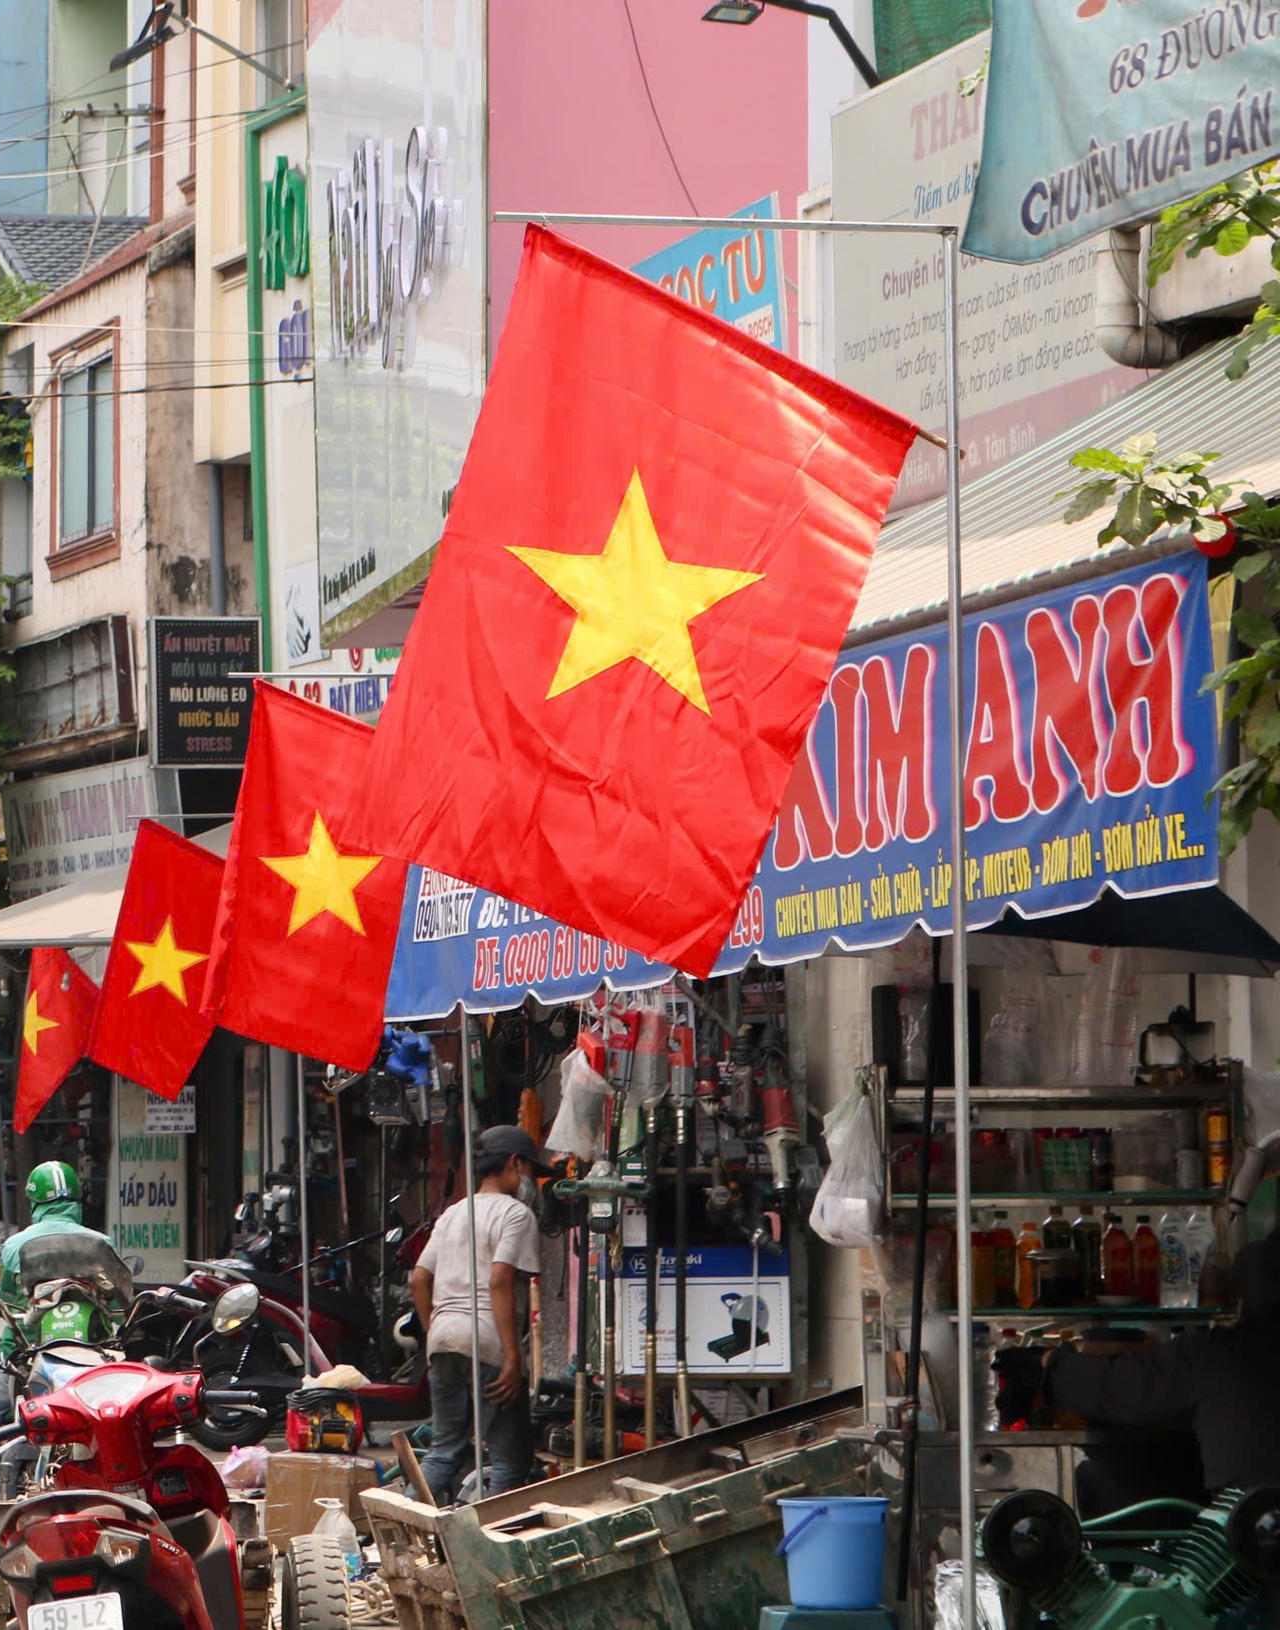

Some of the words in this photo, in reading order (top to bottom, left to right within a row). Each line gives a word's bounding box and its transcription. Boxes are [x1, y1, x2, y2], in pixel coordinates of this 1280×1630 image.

[1108, 41, 1149, 94] 68
[1021, 138, 1120, 236] CHUYÊN
[1126, 119, 1192, 195] MUA
[1203, 83, 1273, 167] BÁN
[914, 180, 943, 220] Tiệm
[882, 264, 929, 300] Chuyên
[1063, 292, 1094, 322] khoan
[198, 661, 217, 678] VAI
[169, 683, 195, 702] MỎI
[231, 686, 248, 702] EO
[773, 642, 940, 874] KIM
[961, 572, 1196, 834] ANH
[186, 736, 233, 752] STRESS
[60, 782, 112, 843] THANH
[775, 884, 816, 939] CHUYÊN
[815, 886, 840, 931] MUA
[839, 874, 863, 926] BÁN
[871, 862, 893, 920] SỬA
[893, 862, 924, 916] CHỮA
[931, 847, 954, 909] LẮP
[983, 846, 1033, 898] MOTEUR
[1041, 834, 1069, 887] BƠM
[1071, 828, 1093, 881] HƠI
[1102, 821, 1134, 874] BƠM
[1135, 803, 1163, 867] RỬA
[472, 936, 501, 992] ĐT:
[503, 928, 551, 990] 0908
[551, 925, 576, 981] 60
[113, 1223, 149, 1249] TRANG
[42, 1600, 106, 1630] 59-L2
